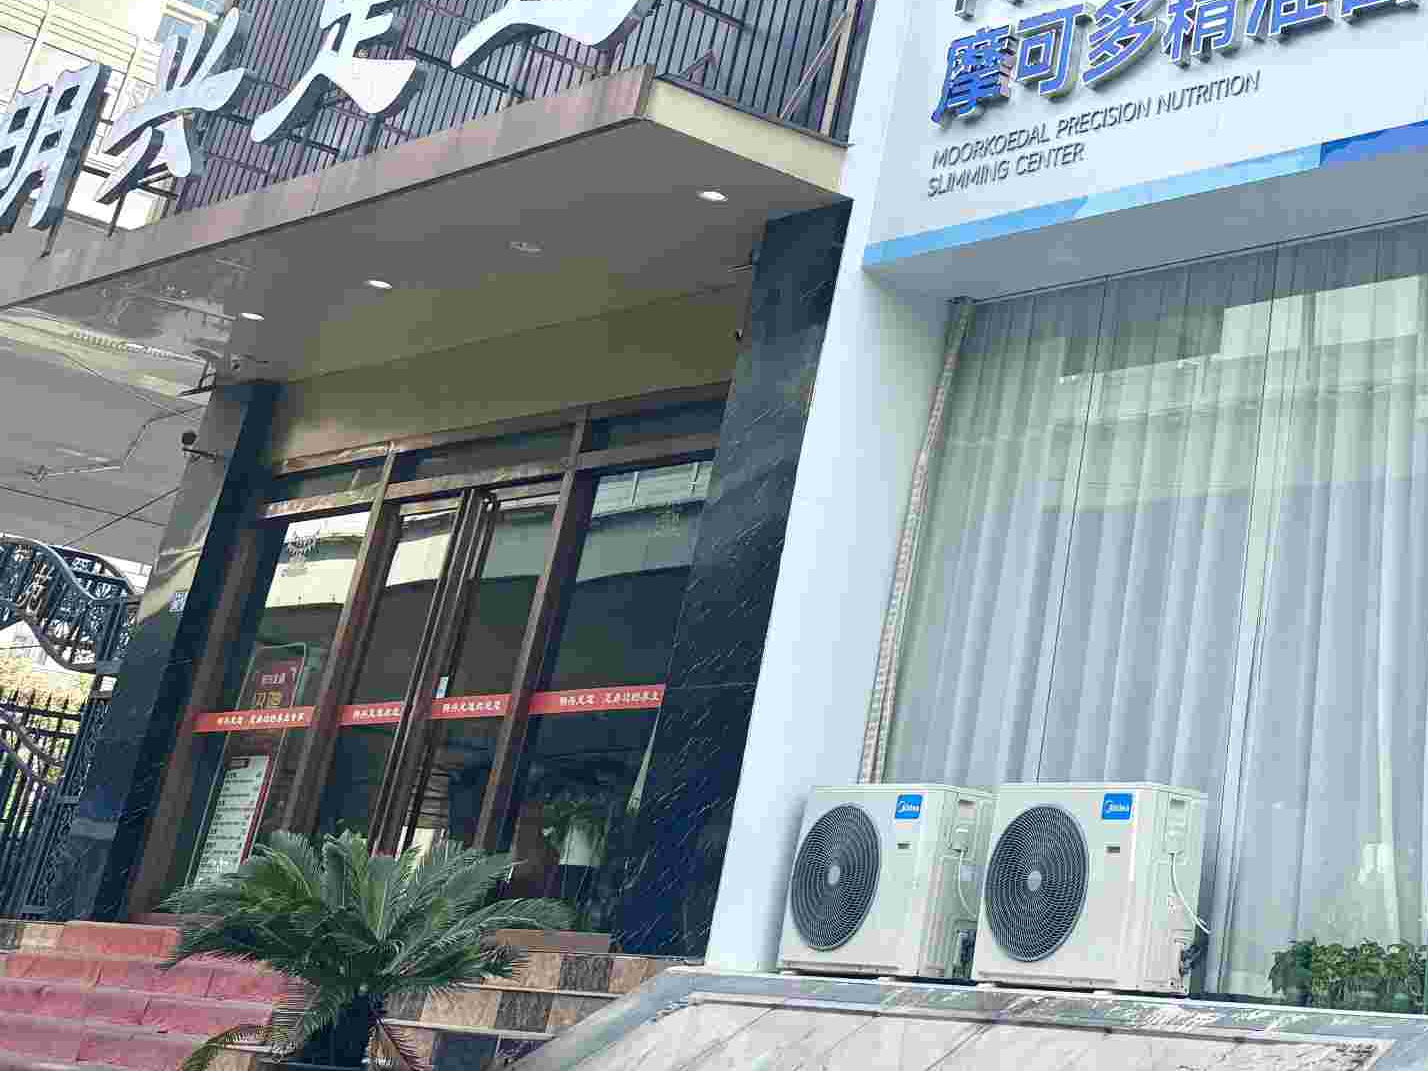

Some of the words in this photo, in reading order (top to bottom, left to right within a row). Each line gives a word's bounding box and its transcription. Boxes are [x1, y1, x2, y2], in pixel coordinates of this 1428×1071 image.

[932, 122, 1050, 170] MOORKOEDAL
[1055, 99, 1151, 142] PRECISION
[1157, 69, 1262, 117] NUTRITION
[927, 160, 1010, 198] SLIMMING
[1015, 141, 1086, 177] CENTER
